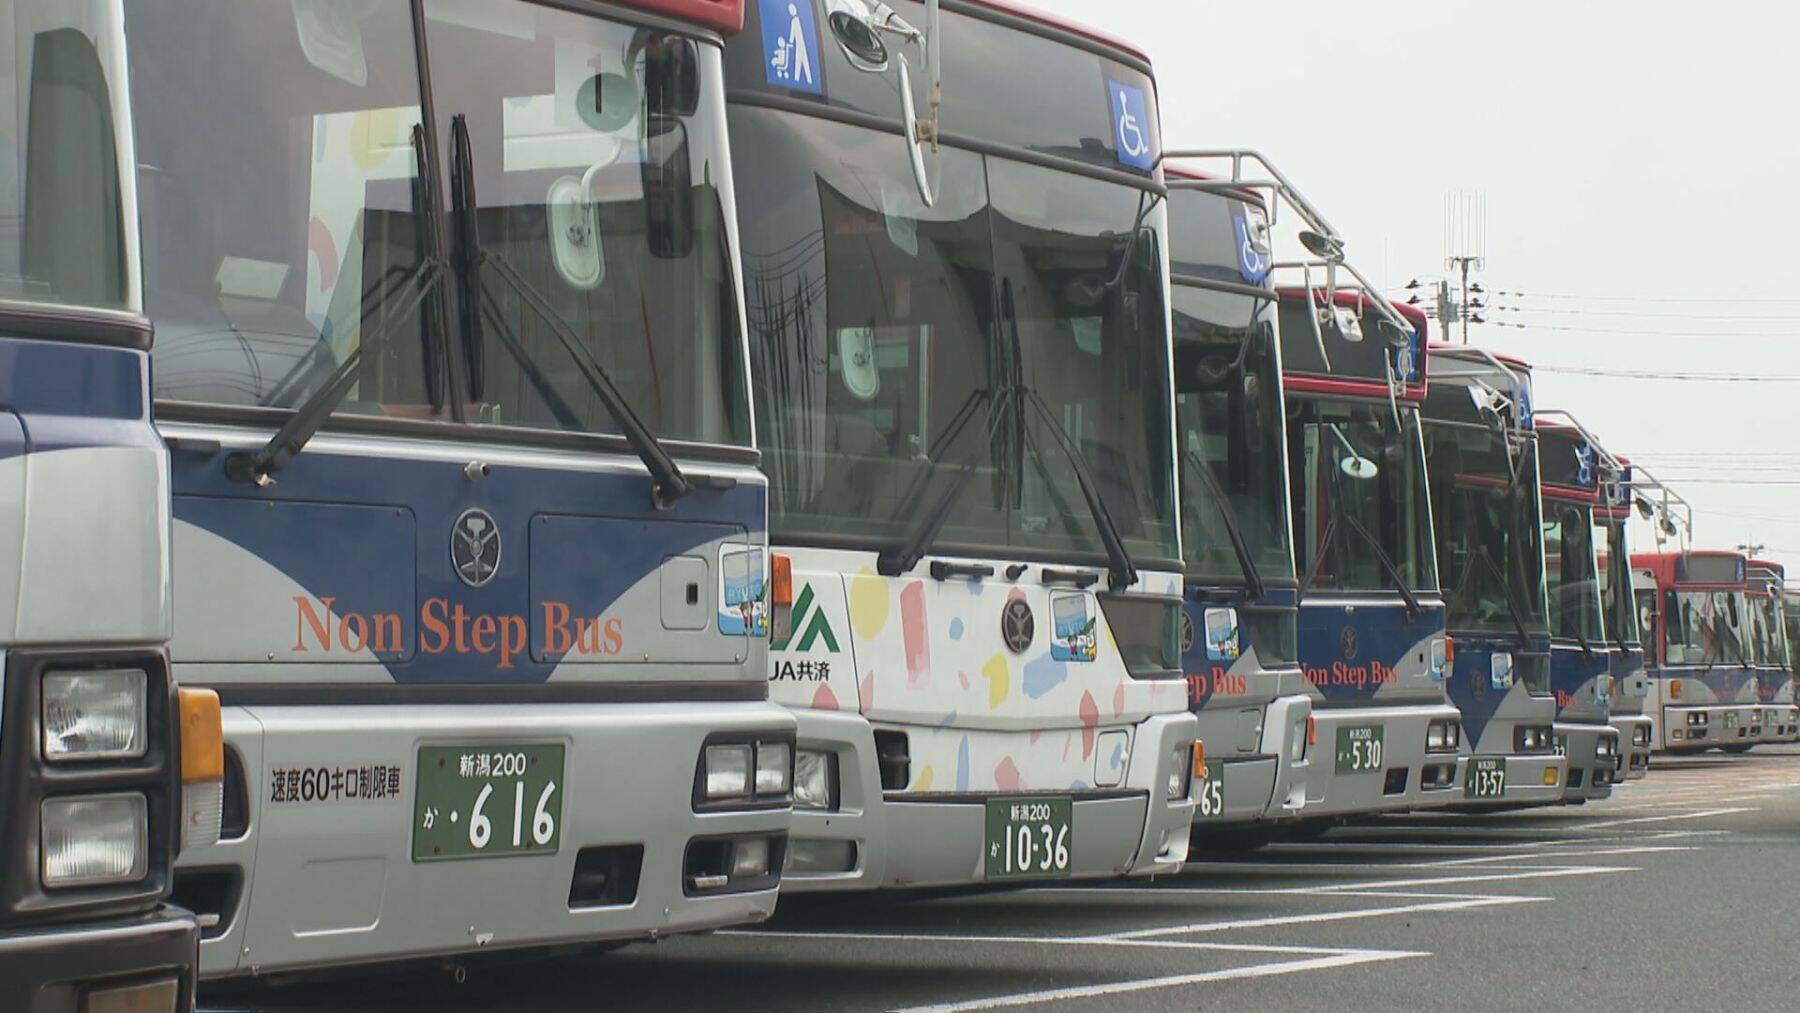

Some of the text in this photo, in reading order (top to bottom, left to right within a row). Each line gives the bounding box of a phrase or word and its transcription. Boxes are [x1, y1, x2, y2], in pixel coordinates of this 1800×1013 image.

[292, 596, 623, 669] Non Step Bus
[768, 661, 830, 681] JA共済
[1211, 666, 1248, 697] Bus
[1333, 660, 1367, 690] Step
[1371, 660, 1400, 684] Bus
[459, 752, 527, 778] 新潟200
[271, 765, 401, 803] 速度60キロ制限車
[423, 805, 439, 829] か
